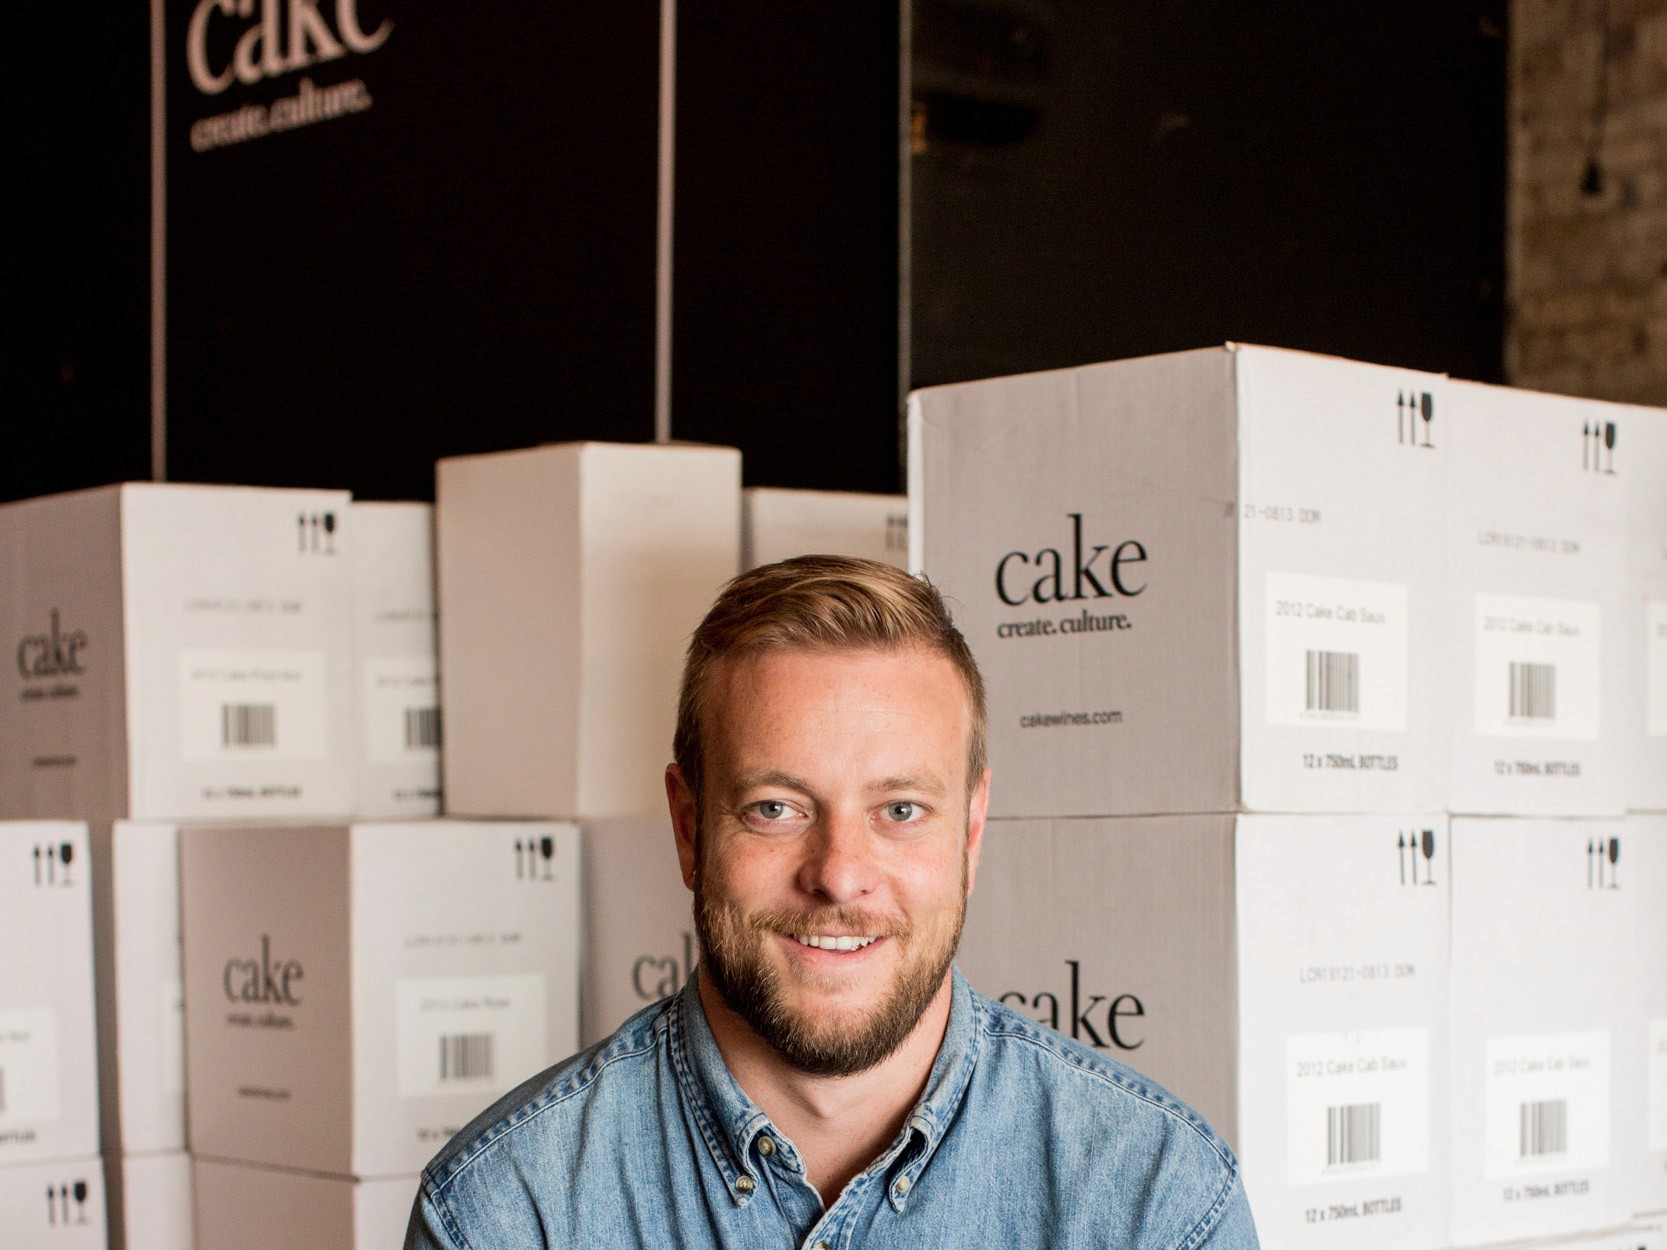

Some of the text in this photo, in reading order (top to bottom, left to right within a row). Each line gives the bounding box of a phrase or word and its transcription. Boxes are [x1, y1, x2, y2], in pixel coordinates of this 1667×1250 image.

[995, 512, 1148, 606] cake
[1276, 599, 1303, 618] 2012
[1306, 602, 1333, 620] Cake
[1336, 604, 1357, 622] Cab
[17, 607, 88, 679] cake
[1020, 709, 1123, 728] cakewines.com
[1303, 753, 1314, 769] 12
[1359, 753, 1398, 771] BOTTLES
[223, 933, 304, 1007] cake
[999, 960, 1145, 1050] ake
[1297, 1060, 1324, 1078] 2012
[1327, 1059, 1355, 1076] Cake
[1357, 1057, 1379, 1073] Cab
[1305, 1207, 1318, 1224] 12
[1362, 1197, 1402, 1216] BOTTLES
